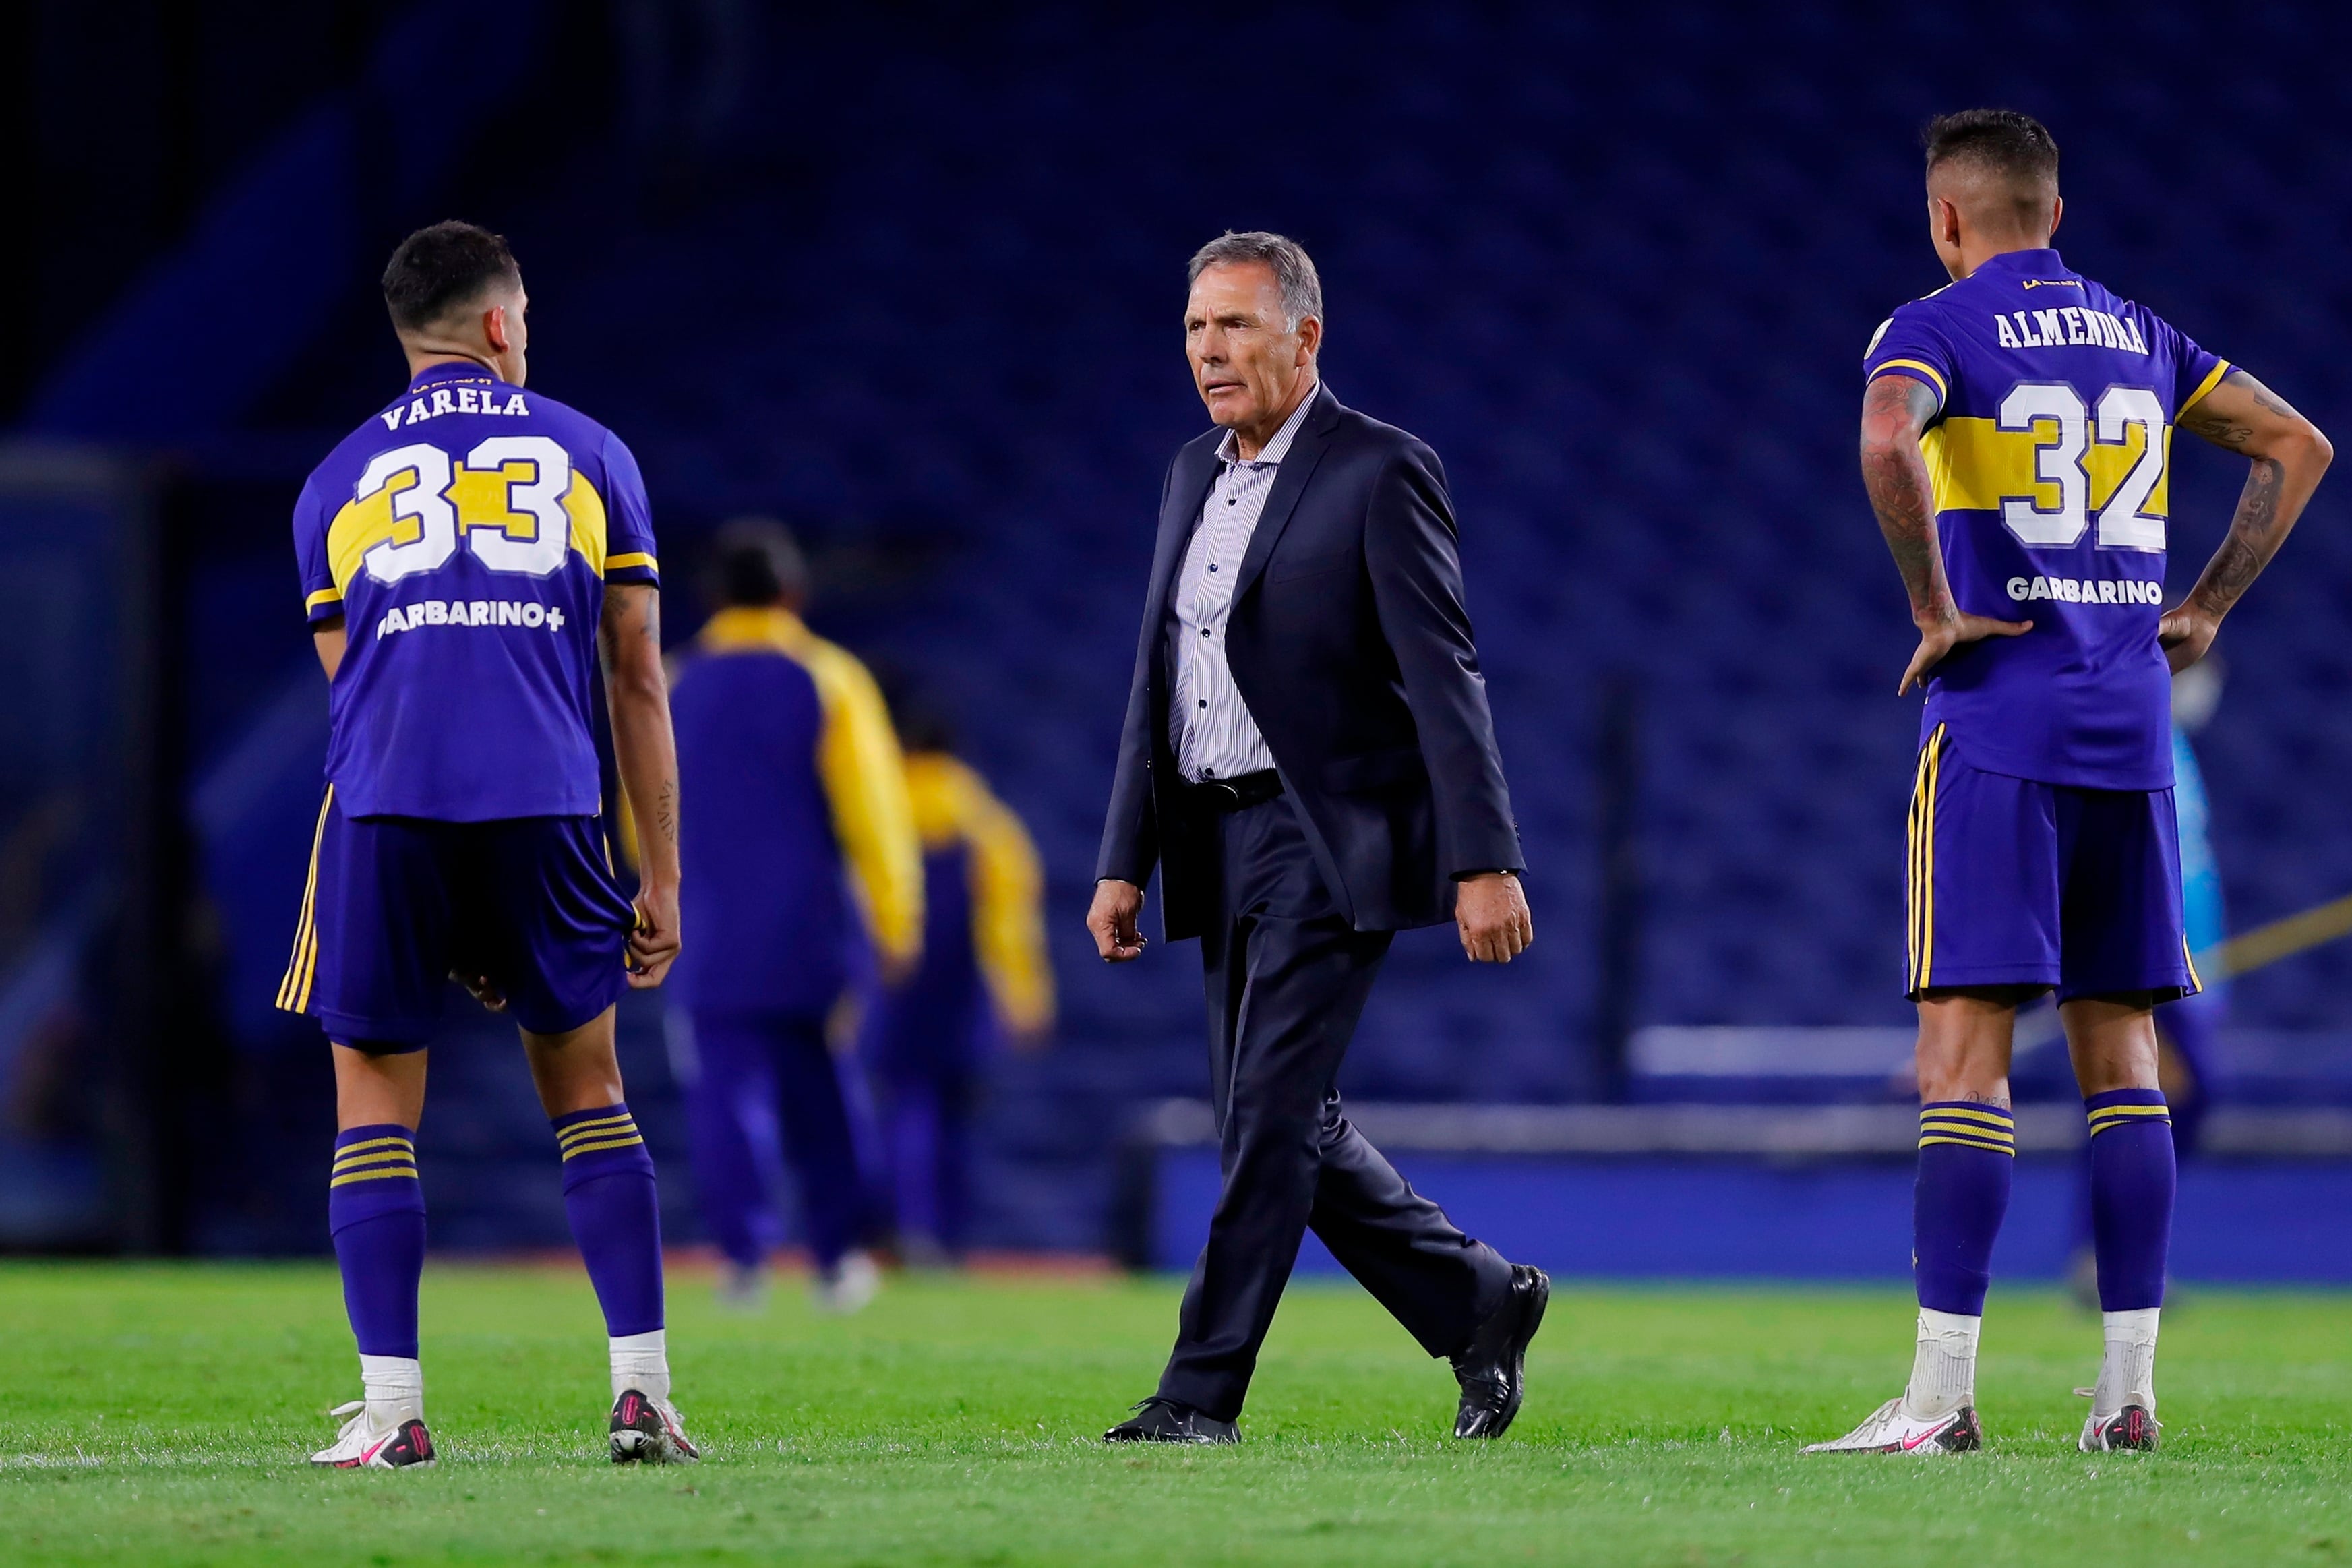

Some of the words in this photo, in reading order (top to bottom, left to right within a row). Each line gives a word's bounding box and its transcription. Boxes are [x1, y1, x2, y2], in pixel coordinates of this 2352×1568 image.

[1994, 306, 2150, 356] ALMENDRA
[382, 387, 529, 431] VARELA
[1997, 382, 2167, 551] 32
[355, 436, 571, 586] 33
[2006, 576, 2163, 605] GARBARINO
